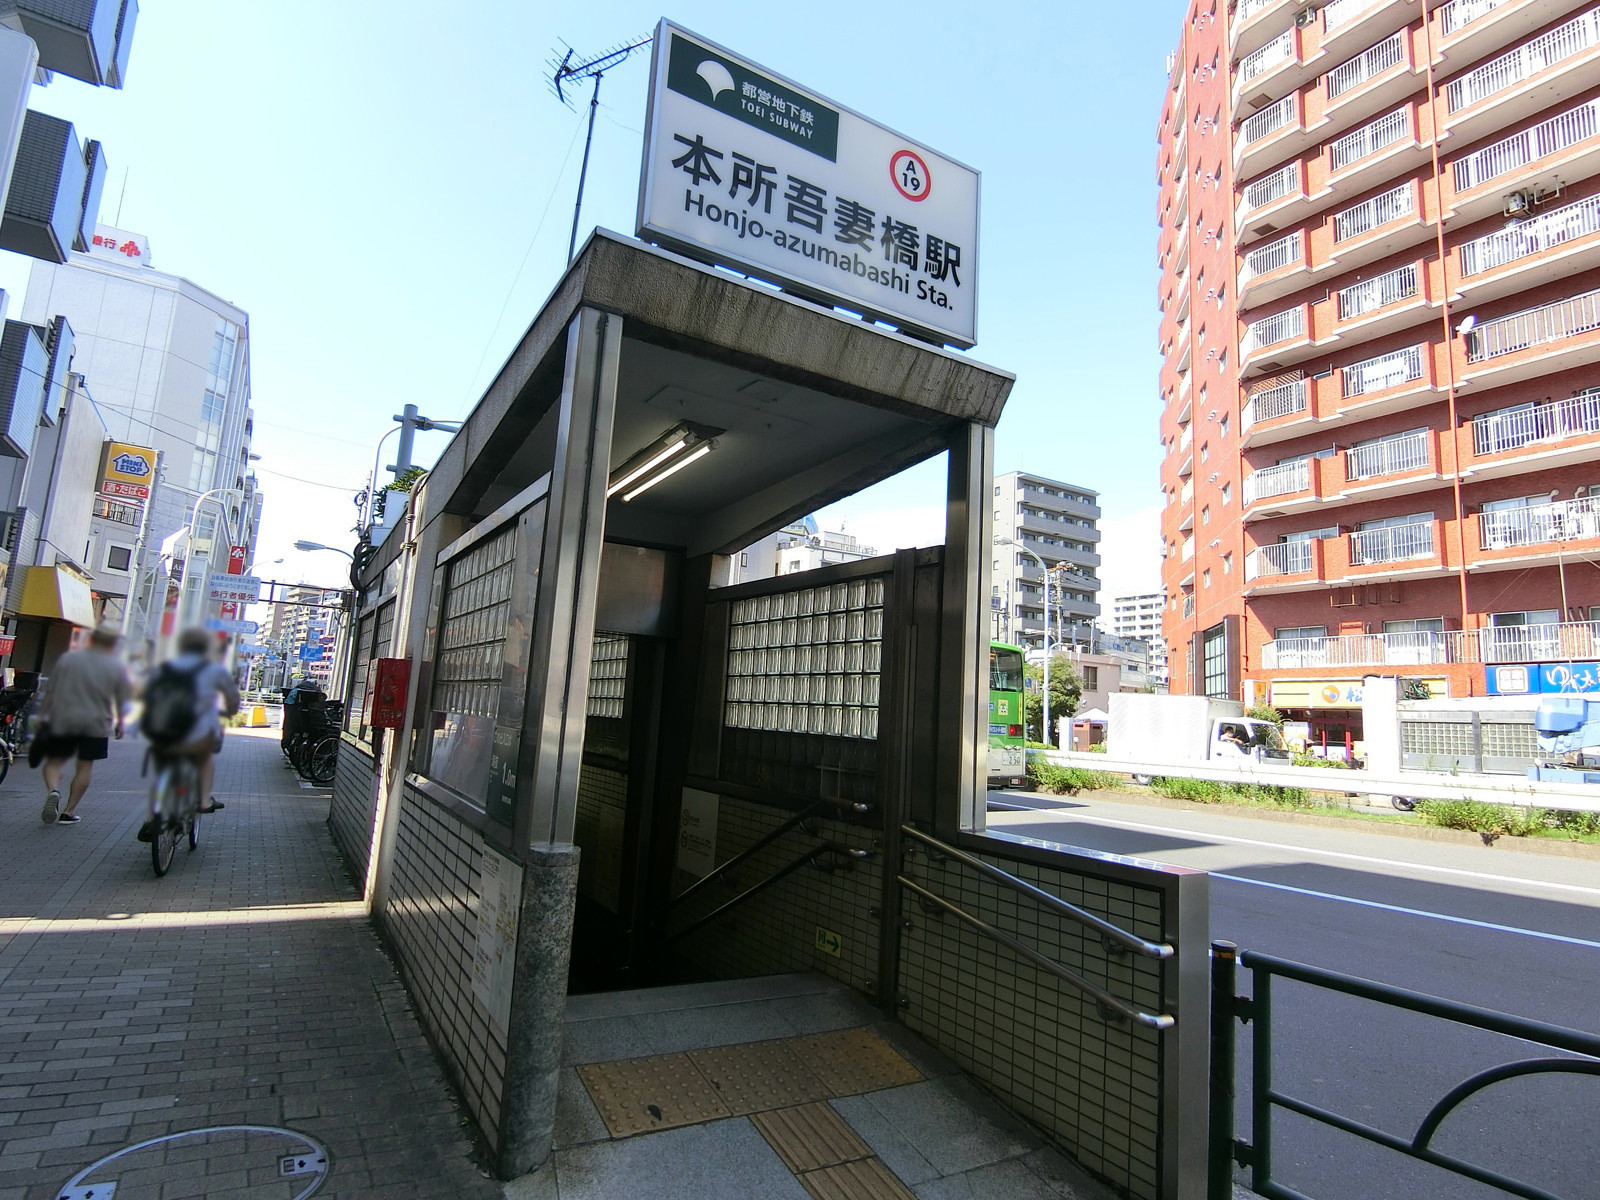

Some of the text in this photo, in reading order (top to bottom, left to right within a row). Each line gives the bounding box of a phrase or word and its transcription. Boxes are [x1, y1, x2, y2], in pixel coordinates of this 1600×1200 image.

[742, 82, 814, 127] 都営地下鉄
[741, 99, 813, 139] TOEI SUBWAY
[905, 160, 917, 175] A
[902, 172, 921, 191] 19
[671, 133, 961, 288] 本所吾妻橋駅
[684, 189, 953, 311] Honjo-azumabashi Sta.
[119, 464, 143, 473] STOP
[121, 458, 143, 468] MINI
[210, 590, 256, 602] 歩行者優先
[1546, 664, 1600, 693] ゆで太
